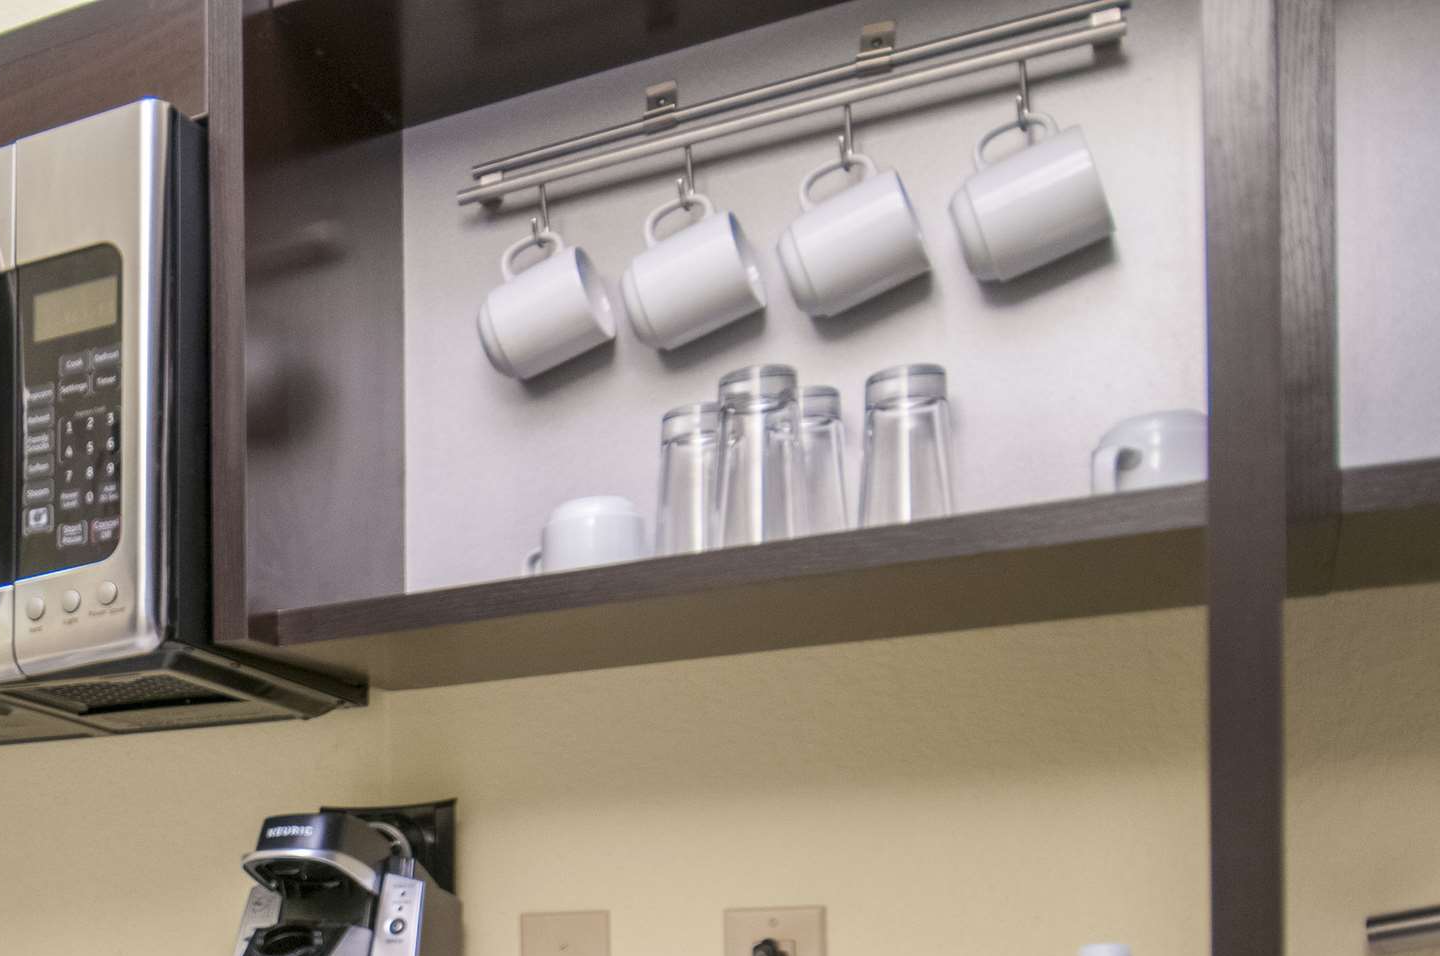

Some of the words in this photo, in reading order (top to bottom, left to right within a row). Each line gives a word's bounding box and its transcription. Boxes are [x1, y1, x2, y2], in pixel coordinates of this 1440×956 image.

[66, 421, 73, 433] 1
[87, 416, 95, 430] 2
[107, 412, 115, 426] 3
[86, 440, 95, 455] 5
[106, 436, 115, 451] 6
[65, 470, 73, 482] 7
[86, 466, 94, 480] 8
[106, 462, 115, 476] 9
[85, 491, 94, 504] 0
[266, 825, 313, 839] KEURIG
